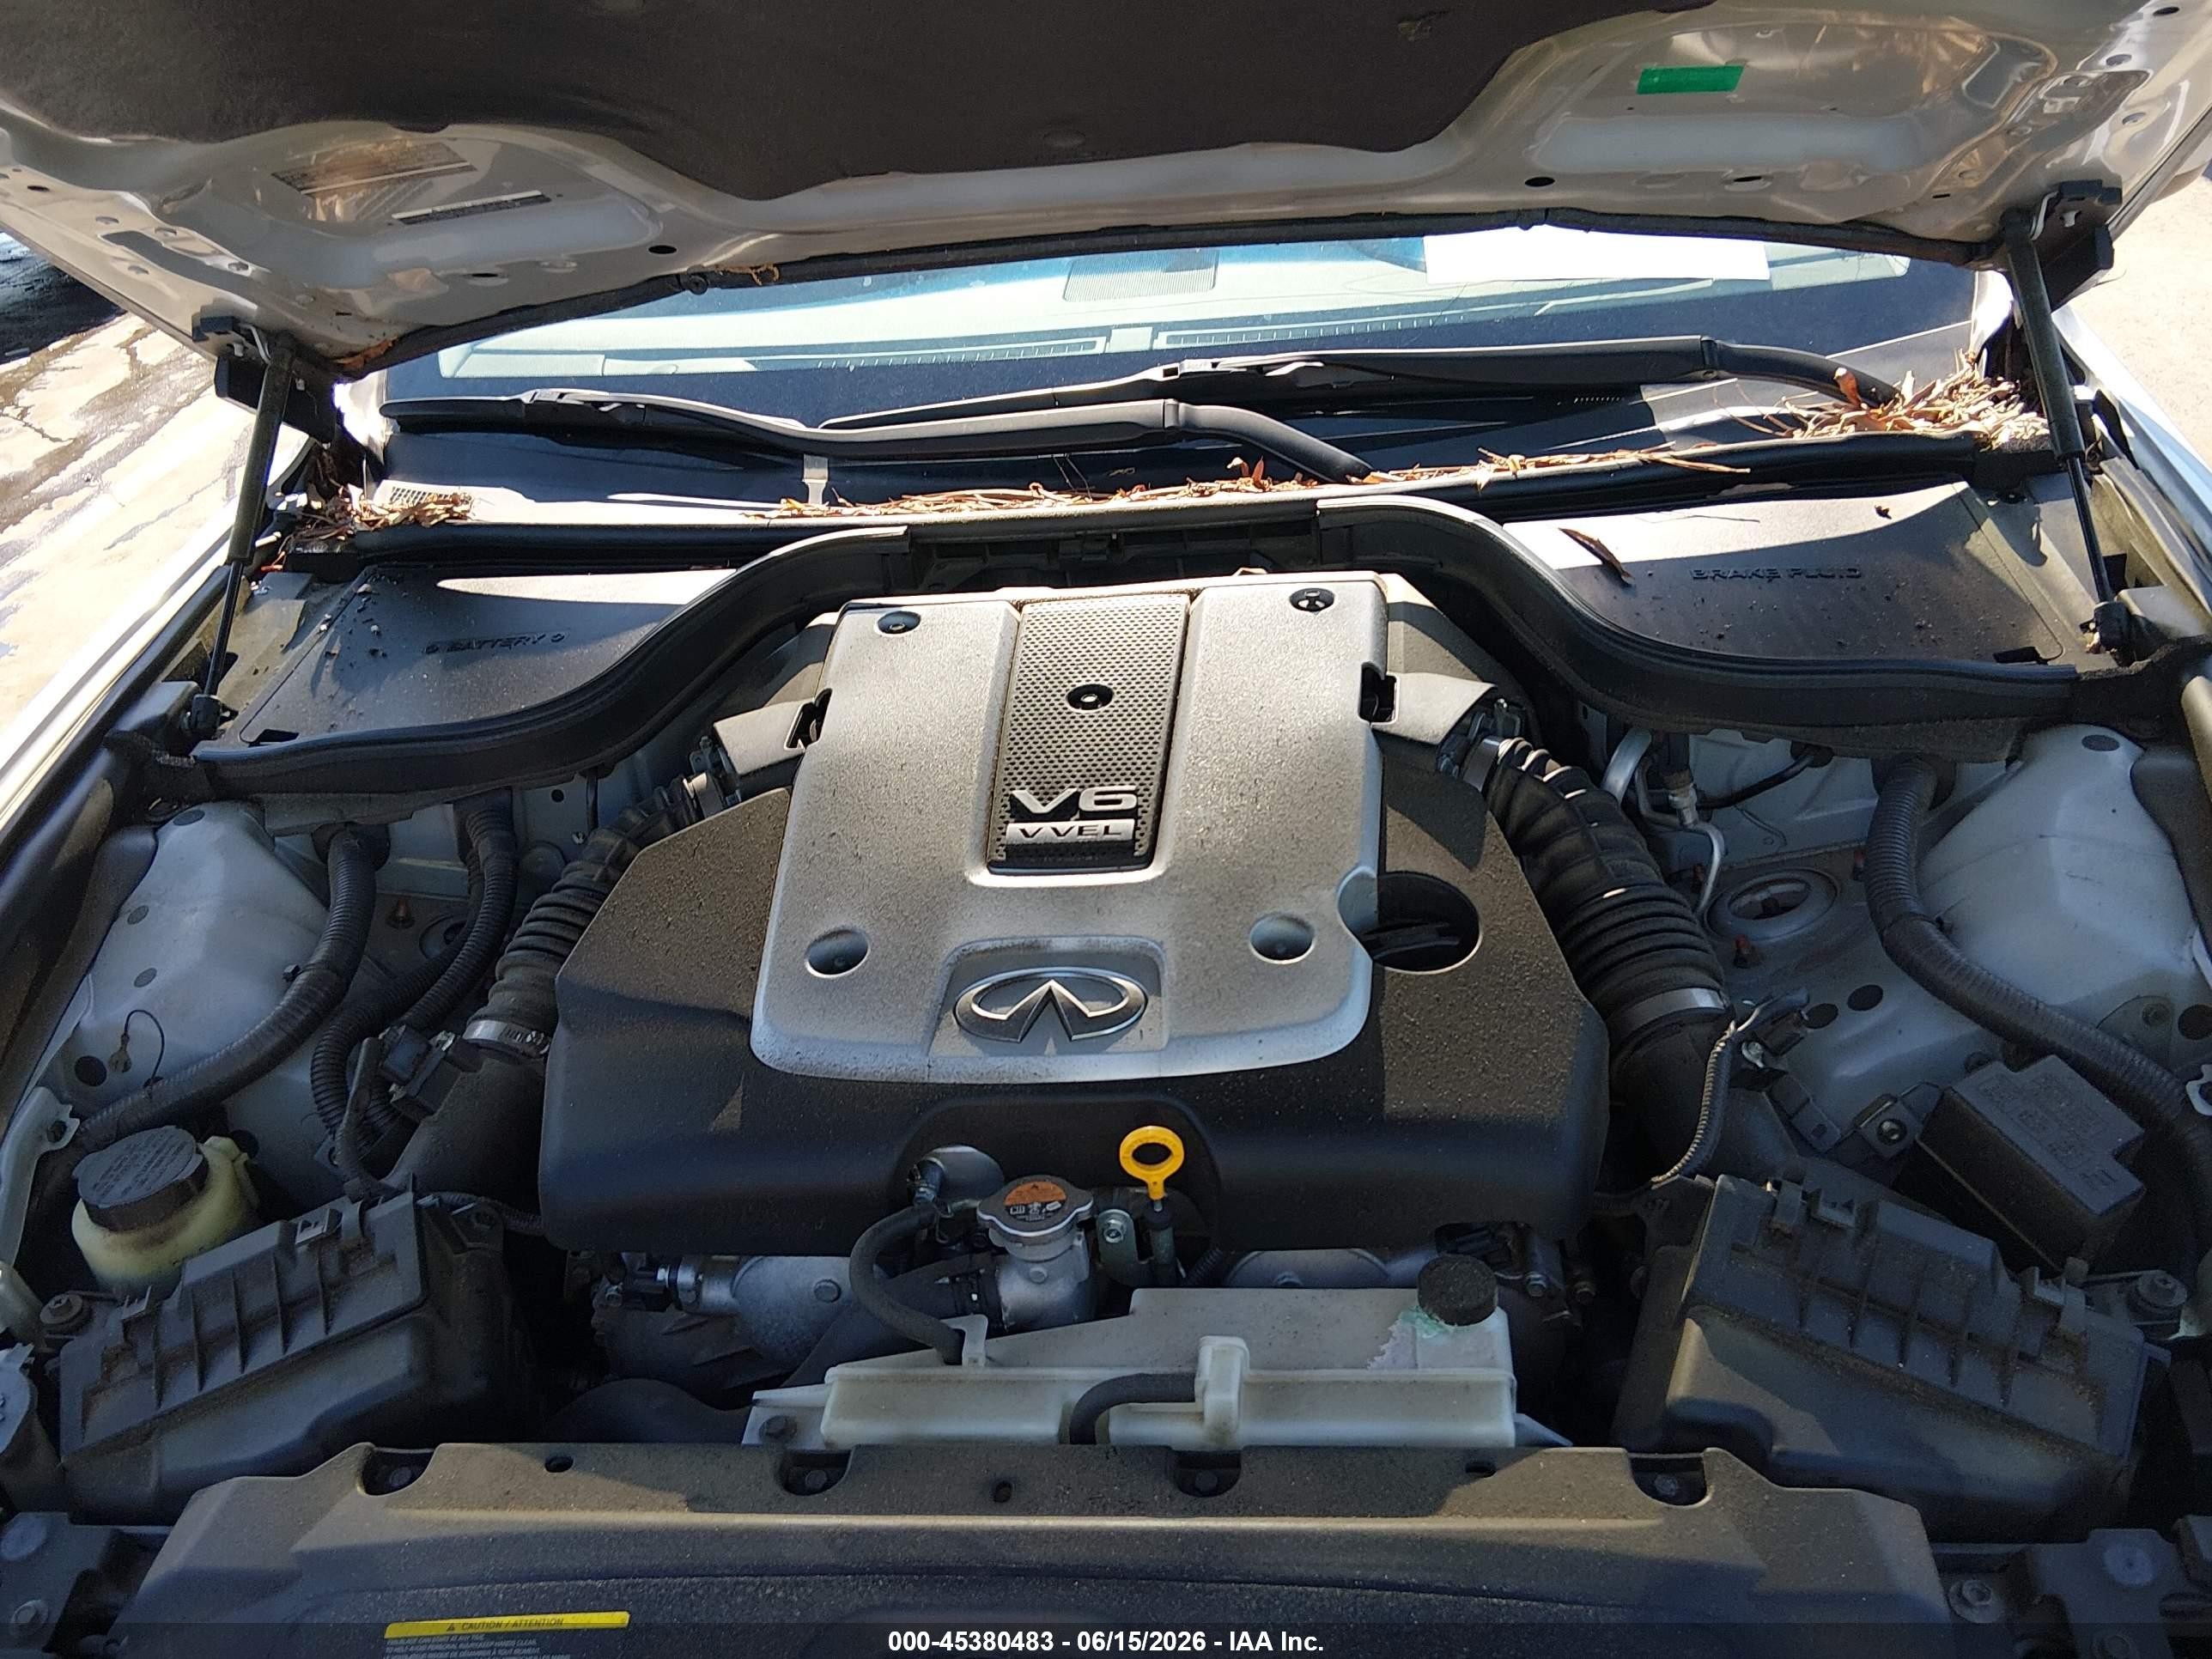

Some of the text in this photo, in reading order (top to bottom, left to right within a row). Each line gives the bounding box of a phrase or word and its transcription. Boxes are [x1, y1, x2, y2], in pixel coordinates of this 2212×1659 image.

[1692, 568, 1862, 580] BRAKE FLUID
[446, 634, 546, 653] BATTERY
[1011, 784, 1139, 814] V6
[1018, 823, 1122, 839] VVEL
[461, 1620, 503, 1631] CAUTION
[512, 1618, 564, 1628] ATTENTION
